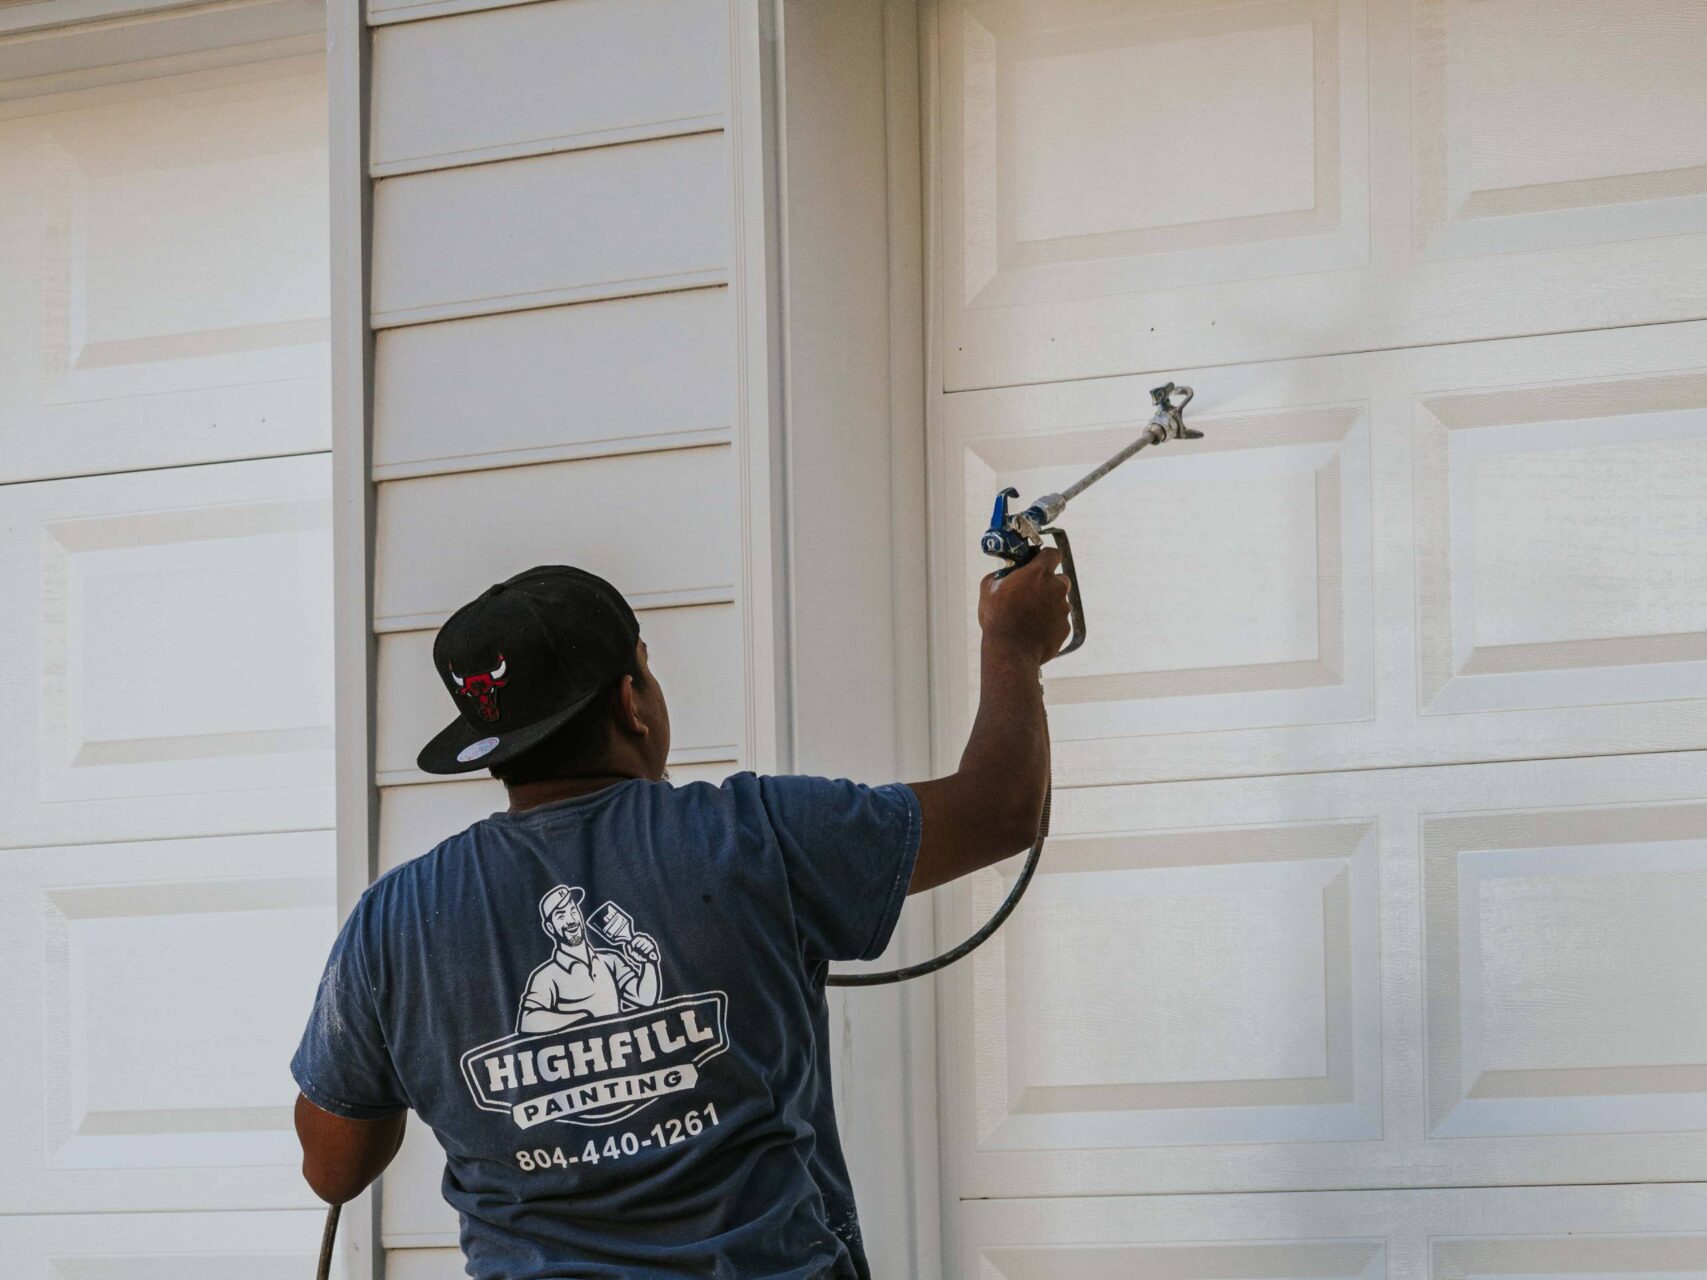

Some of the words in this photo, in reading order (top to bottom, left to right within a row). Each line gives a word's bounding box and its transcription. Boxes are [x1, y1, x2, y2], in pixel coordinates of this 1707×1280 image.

[484, 1010, 714, 1092] HIGHFILL
[523, 1070, 682, 1122] PAINTING
[516, 1102, 720, 1171] 804-440-1261
